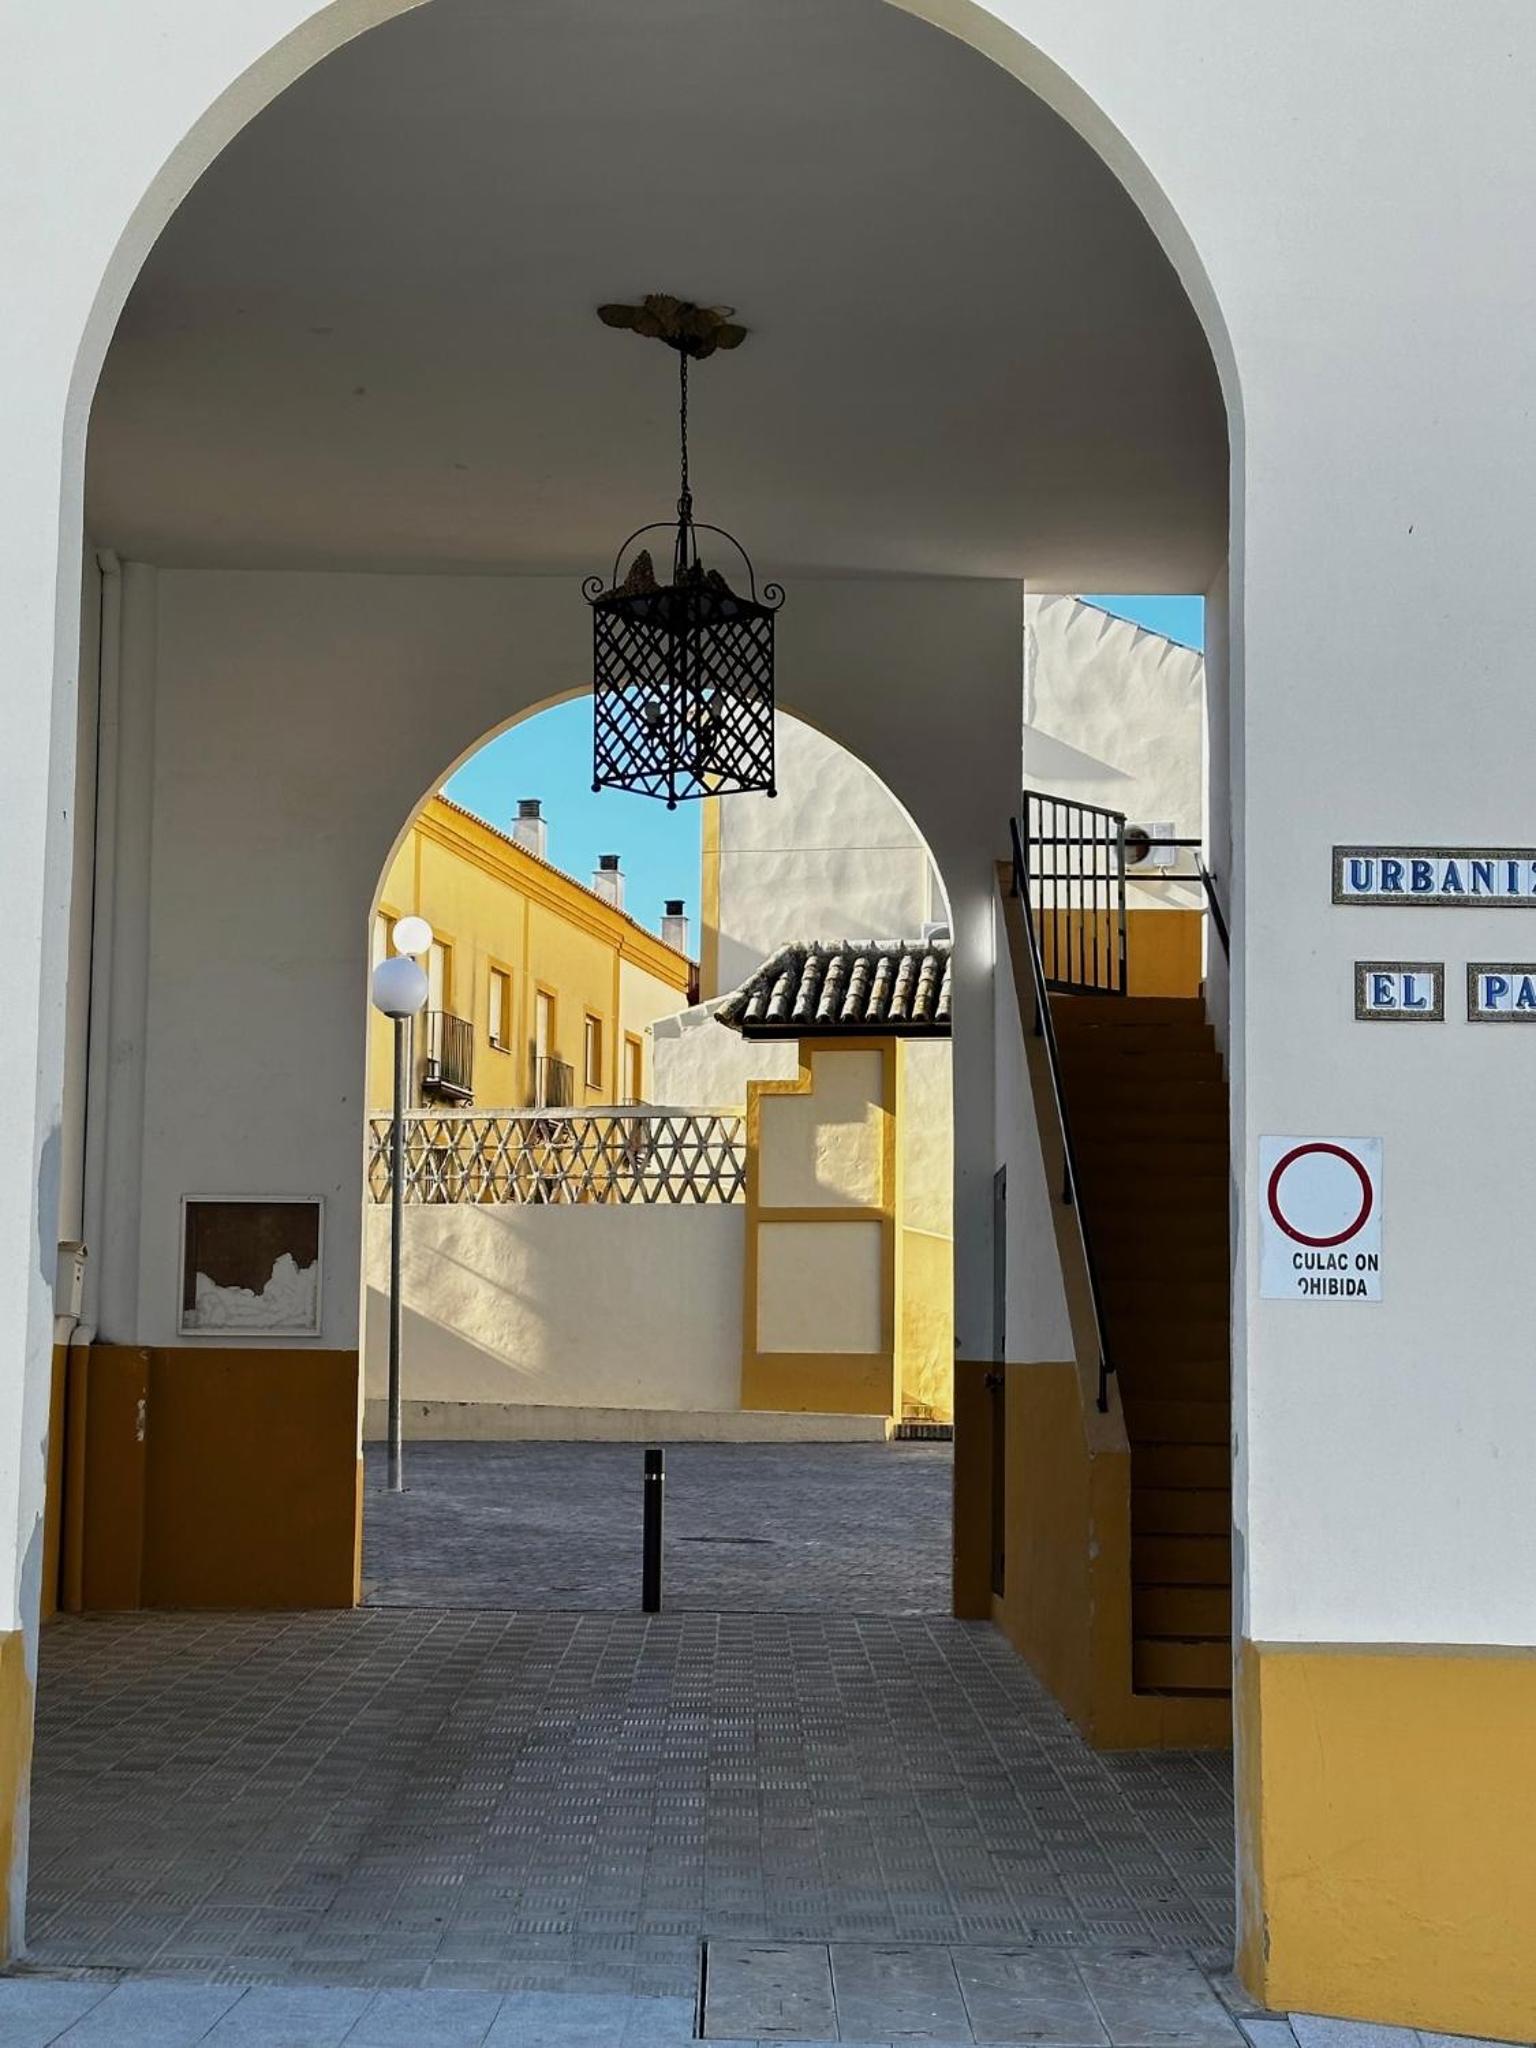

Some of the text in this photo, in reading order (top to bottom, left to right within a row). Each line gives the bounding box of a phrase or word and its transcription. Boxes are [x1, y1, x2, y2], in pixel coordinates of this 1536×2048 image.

[1350, 859, 1536, 894] URBANI
[1372, 974, 1536, 1009] EL PA
